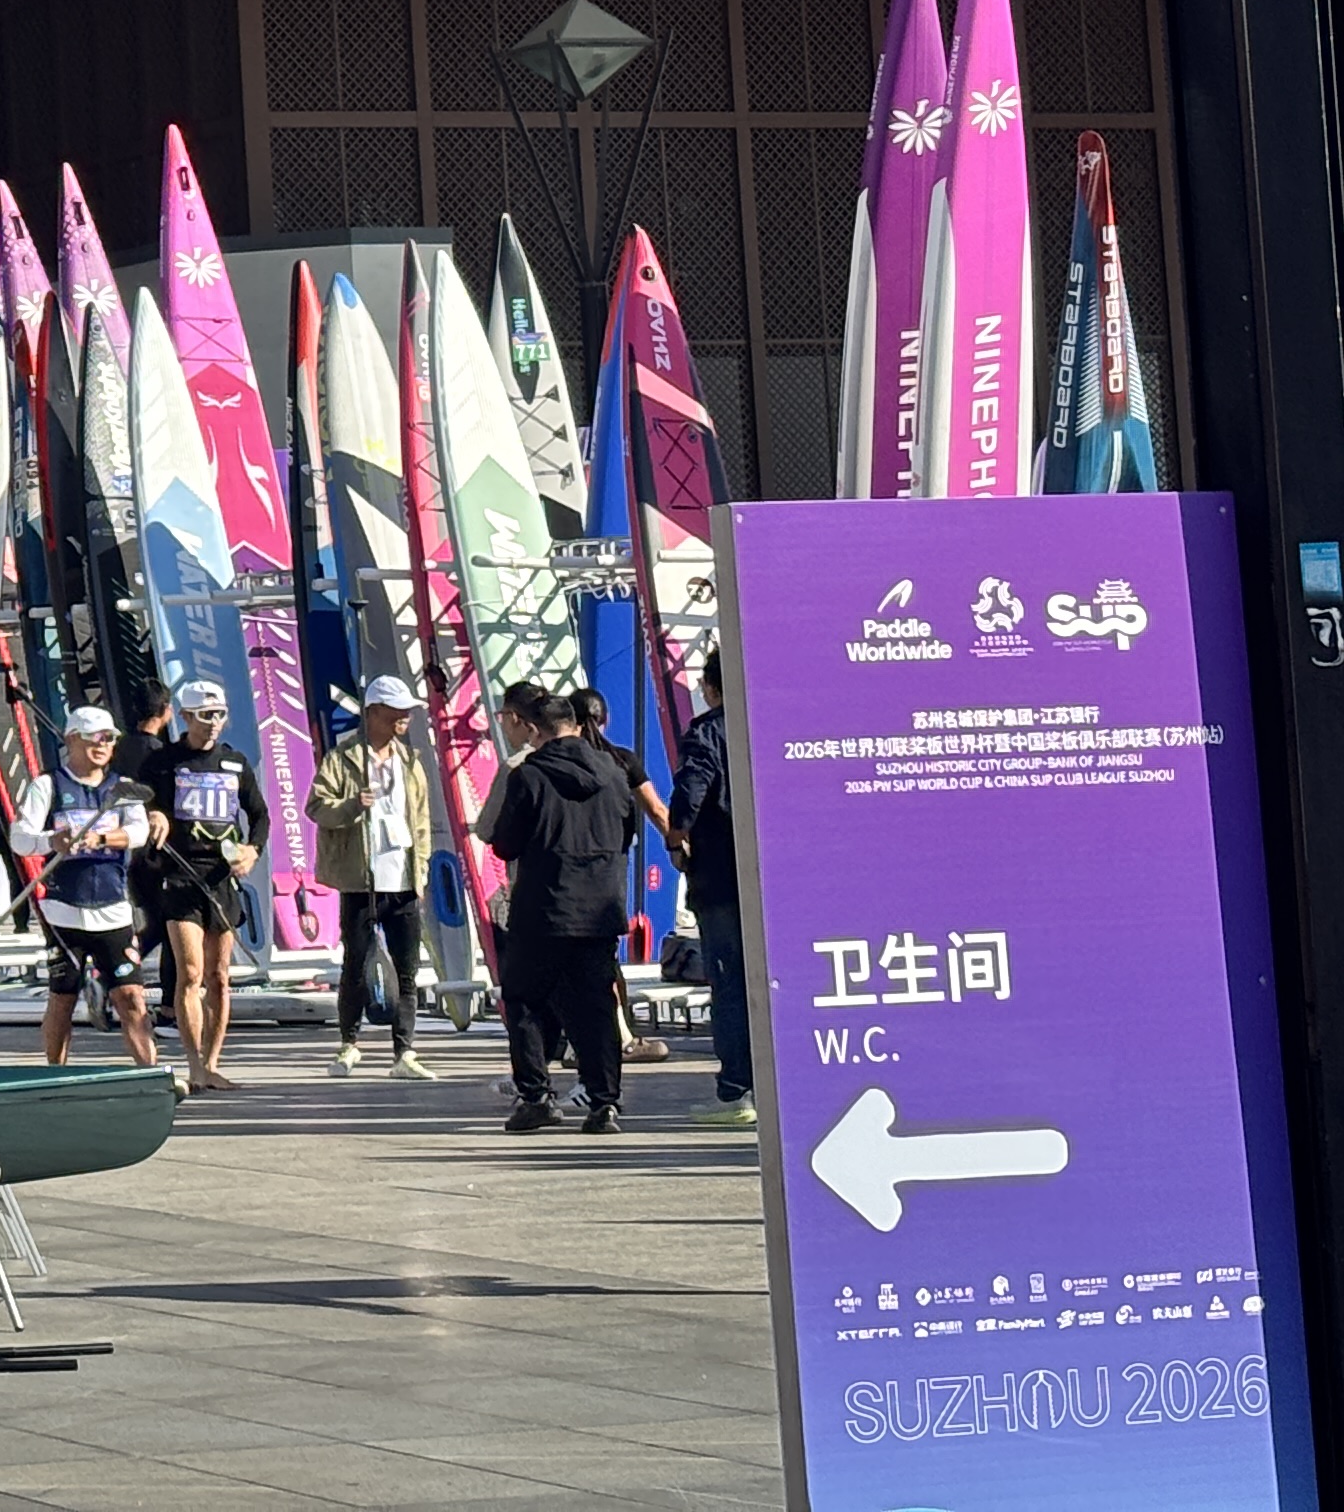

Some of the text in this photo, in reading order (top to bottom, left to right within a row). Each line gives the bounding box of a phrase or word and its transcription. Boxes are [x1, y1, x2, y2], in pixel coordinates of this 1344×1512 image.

[515, 343, 548, 359] 771
[970, 314, 1002, 498] NINEPH
[863, 619, 932, 639] Paddle
[845, 640, 953, 662] Worldwide
[875, 761, 923, 776] SUZHOU
[925, 759, 977, 774] HISTORIC
[978, 758, 1001, 772] CITY
[1078, 755, 1093, 768] OF
[1096, 752, 1143, 767] JIANGSU
[844, 768, 1175, 794] 2026 PW SUP WORLD CUP & CHINA SUP CLUB LEAGUE SUZHOU
[181, 789, 229, 818] 411
[269, 733, 307, 869] NINEPHOENIX
[812, 931, 1012, 1007] 卫生间
[813, 1026, 901, 1065] W.C.
[843, 1354, 1270, 1445] SUZHOU 2026
